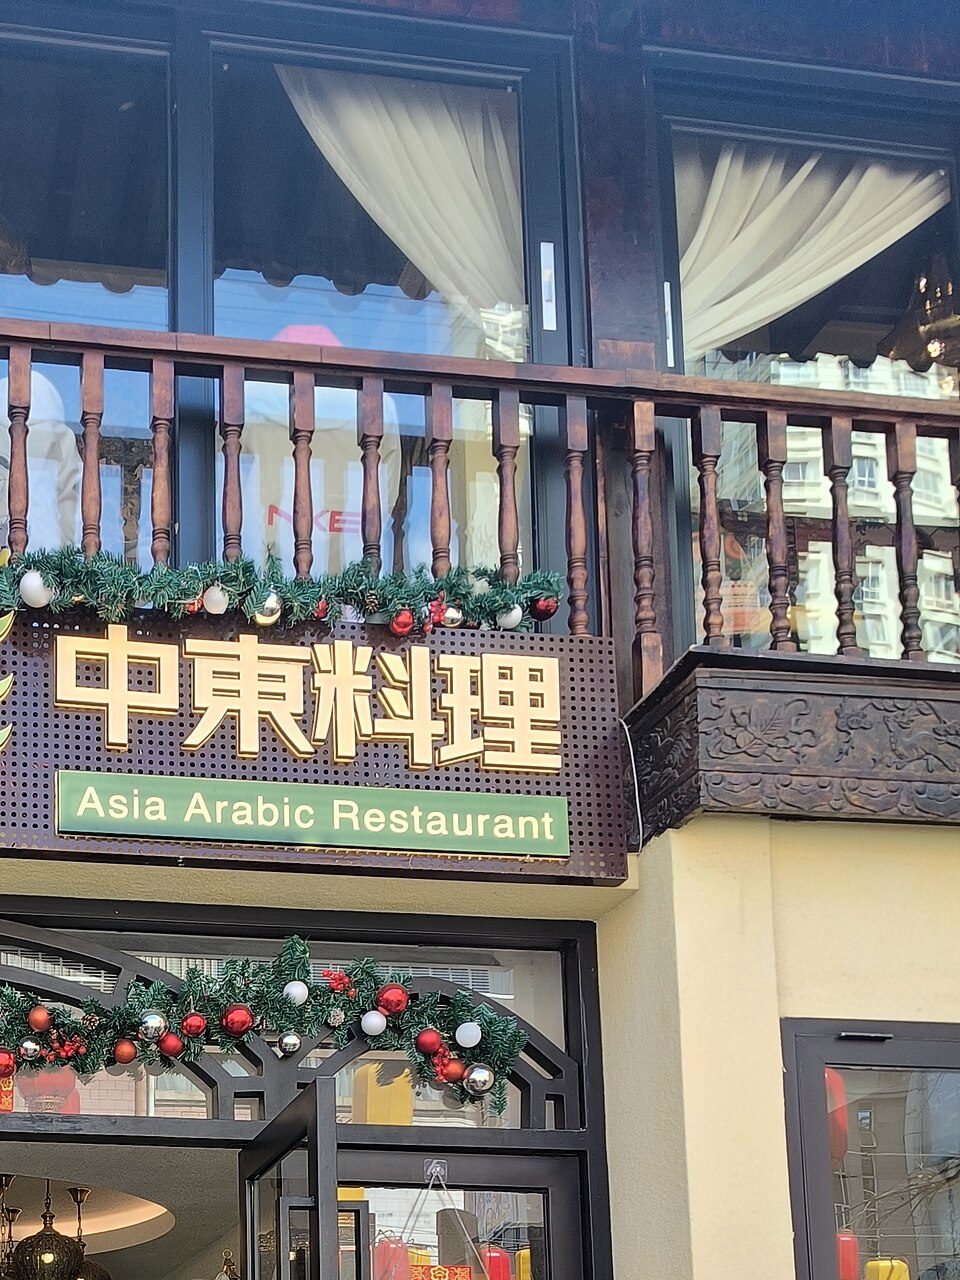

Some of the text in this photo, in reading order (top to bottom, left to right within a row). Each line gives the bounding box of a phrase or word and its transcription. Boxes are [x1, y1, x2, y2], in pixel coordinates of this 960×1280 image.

[54, 624, 563, 772] 中東料理
[76, 786, 555, 841] Asia Arabic Restaurant
